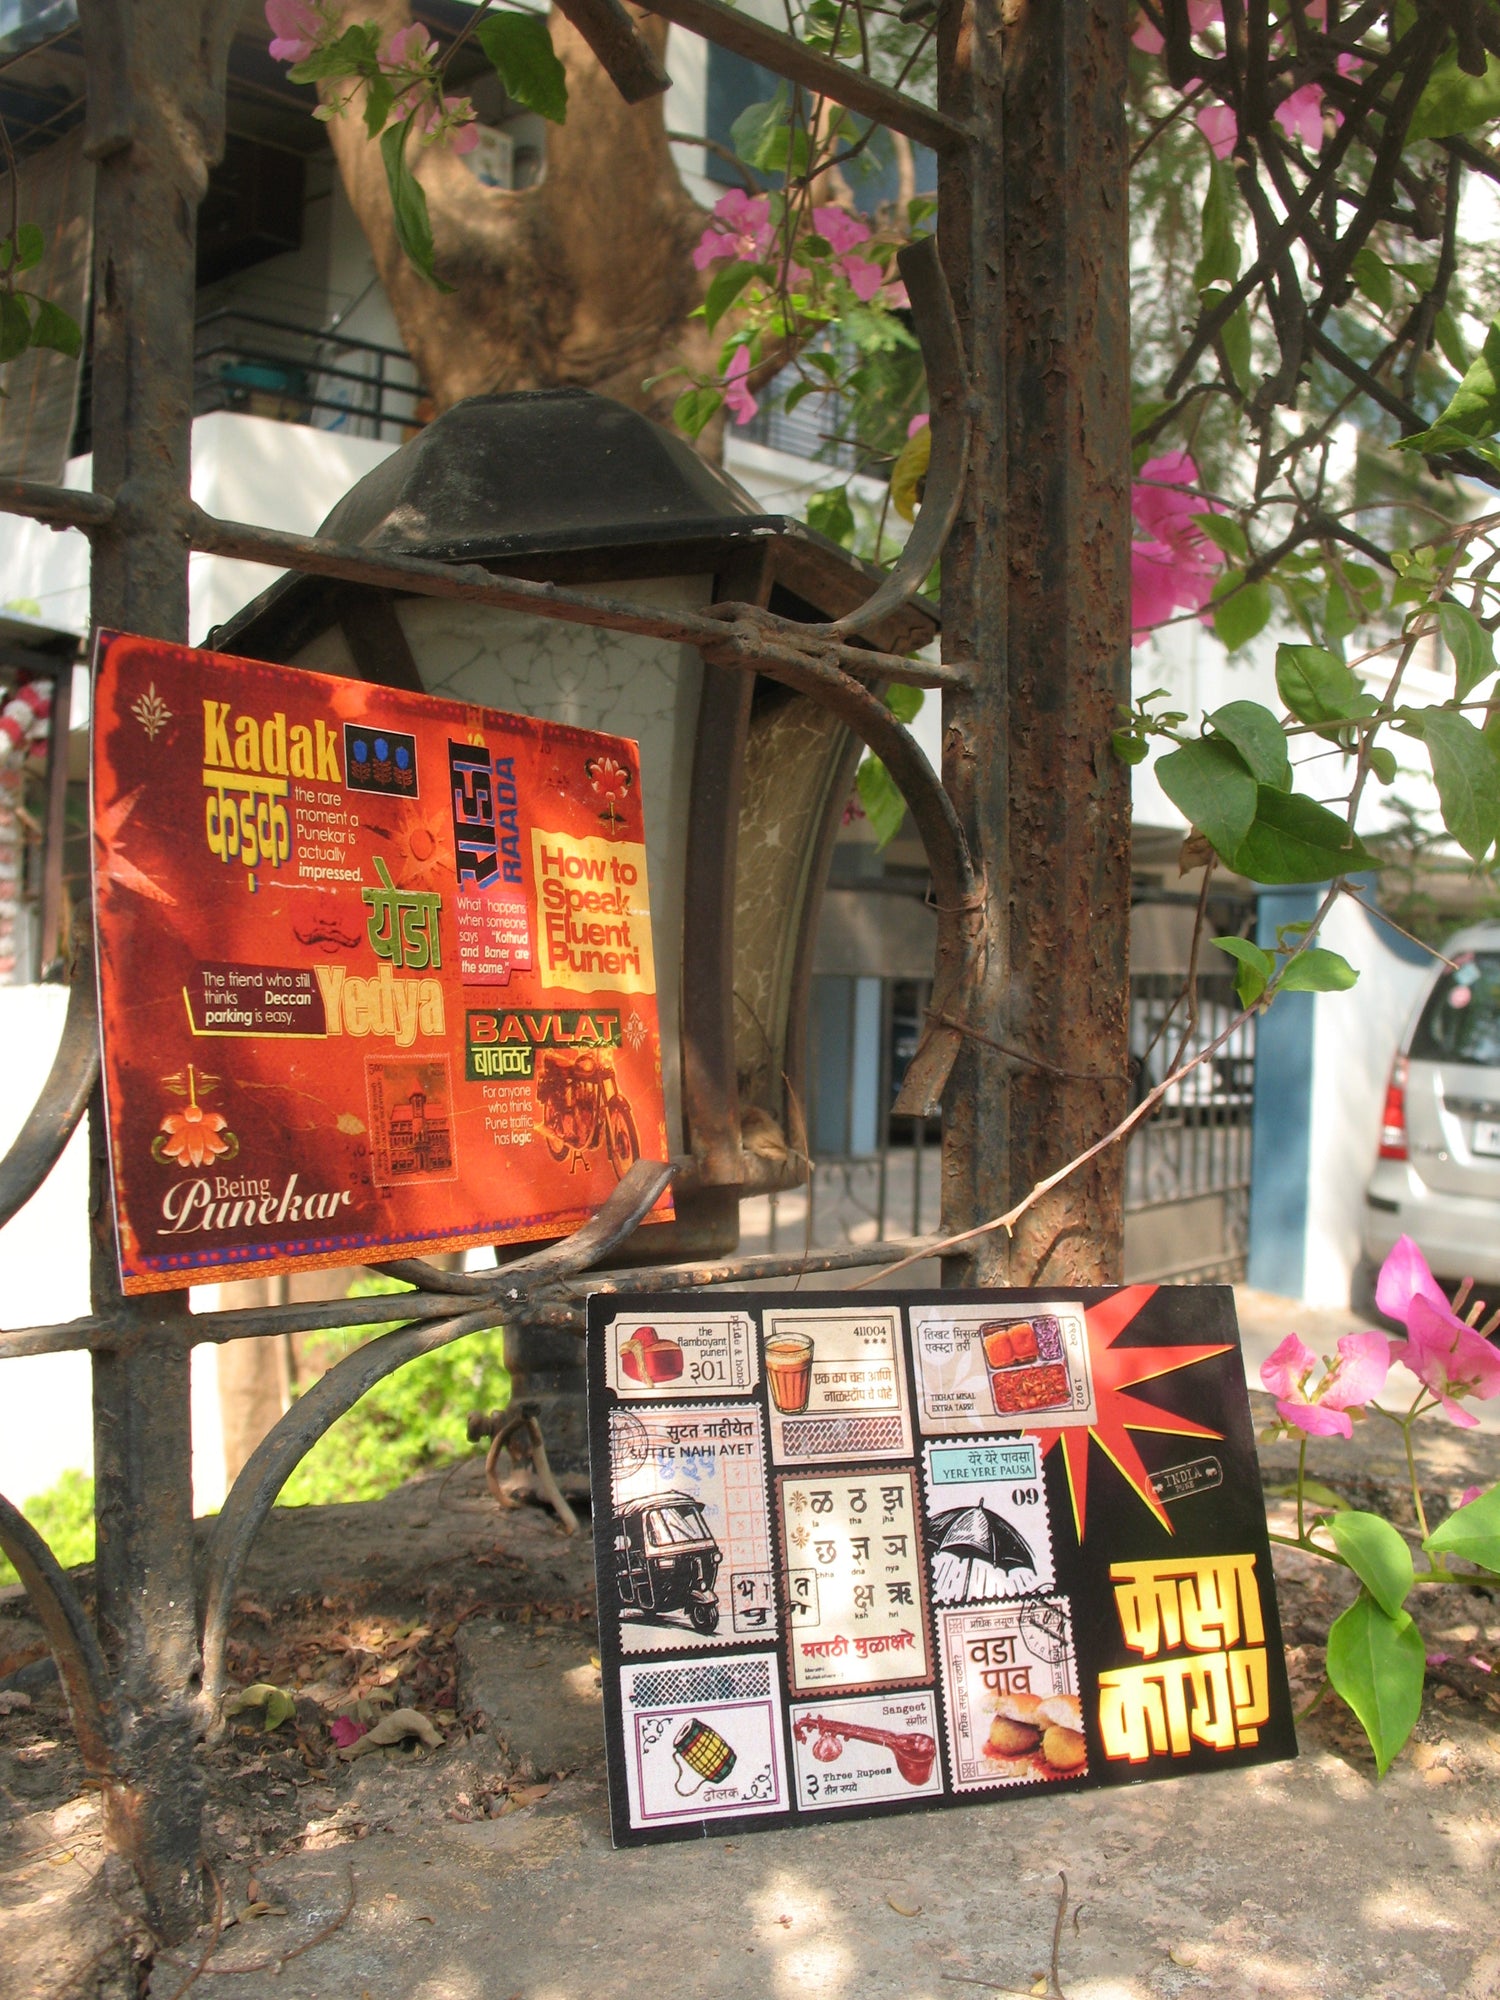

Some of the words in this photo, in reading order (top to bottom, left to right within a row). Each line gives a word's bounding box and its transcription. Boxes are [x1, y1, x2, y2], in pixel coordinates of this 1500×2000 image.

[203, 700, 342, 783] Kadak
[295, 786, 314, 803] the
[318, 792, 341, 806] rare
[296, 808, 347, 825] moment
[350, 815, 359, 827] a
[496, 757, 522, 883] RAADA
[202, 769, 290, 892] कडक
[297, 824, 346, 843] Punekar
[348, 830, 356, 844] is
[298, 845, 345, 864] actually
[299, 862, 363, 882] impressed.
[540, 845, 607, 882] How
[611, 856, 637, 885] to
[457, 897, 481, 911] What
[488, 899, 526, 915] happens
[542, 878, 630, 916] Speak
[361, 856, 441, 968] येडा
[458, 913, 484, 927] when
[486, 917, 527, 929] someone
[459, 931, 478, 944] says
[546, 912, 631, 947] Fluent
[461, 945, 479, 957] and
[484, 945, 509, 958] Baner
[515, 949, 529, 959] are
[549, 942, 640, 975] Puneri
[461, 960, 476, 973] the
[203, 972, 225, 986] The
[229, 972, 263, 987] friend
[266, 973, 292, 987] who
[296, 974, 311, 987] still
[204, 990, 238, 1004] thinks
[265, 991, 311, 1005] Deccan
[313, 963, 446, 1047] Yedya
[205, 1009, 252, 1026] parking
[255, 1008, 262, 1022] is
[265, 1011, 296, 1025] easy.
[468, 1014, 618, 1043] BAVLAT
[471, 1046, 532, 1075] बावळट
[483, 1086, 495, 1098] For
[498, 1086, 531, 1099] anyone
[488, 1102, 507, 1113] who
[510, 1101, 532, 1112] thinks
[485, 1117, 507, 1130] Pune
[510, 1115, 533, 1128] traffic
[494, 1132, 509, 1145] has
[511, 1131, 534, 1146] logic.
[215, 1175, 271, 1202] Being
[157, 1173, 353, 1235] Punekar
[698, 1327, 712, 1336] the
[853, 1326, 886, 1336] 411004
[924, 1328, 949, 1340] तिखट
[677, 1337, 728, 1348] flamboyant
[700, 1348, 728, 1359] puneri
[814, 1373, 830, 1385] एक
[1074, 1378, 1084, 1405] 1902
[931, 1405, 953, 1413] EXTRA
[703, 1418, 753, 1438] नाहीयेत
[680, 1445, 715, 1457] NAHI
[719, 1443, 753, 1456] AYET
[1000, 1452, 1030, 1463] पावसा
[943, 1469, 970, 1479] YERE
[971, 1467, 997, 1477] YERE
[1000, 1465, 1032, 1475] PAUSA
[810, 1490, 834, 1514] ळ
[847, 1488, 867, 1513] ठ
[880, 1486, 904, 1515] झ
[1012, 1488, 1039, 1506] 09
[882, 1515, 894, 1524] jha
[813, 1540, 837, 1564] छ
[849, 1537, 870, 1565] ज्ञ
[885, 1565, 899, 1573] nya
[853, 1585, 875, 1611] क्ष
[885, 1582, 914, 1605] ऋ
[801, 1635, 848, 1659] मराठी
[853, 1629, 916, 1659] मुळाक्षरे
[966, 1636, 1018, 1666] वडा
[979, 1665, 1033, 1697] पाव
[882, 1702, 927, 1715] Sangeet
[905, 1715, 928, 1727] संगीत
[823, 1773, 852, 1782] Three
[857, 1767, 892, 1778] Rupees
[806, 1774, 820, 1800] ३
